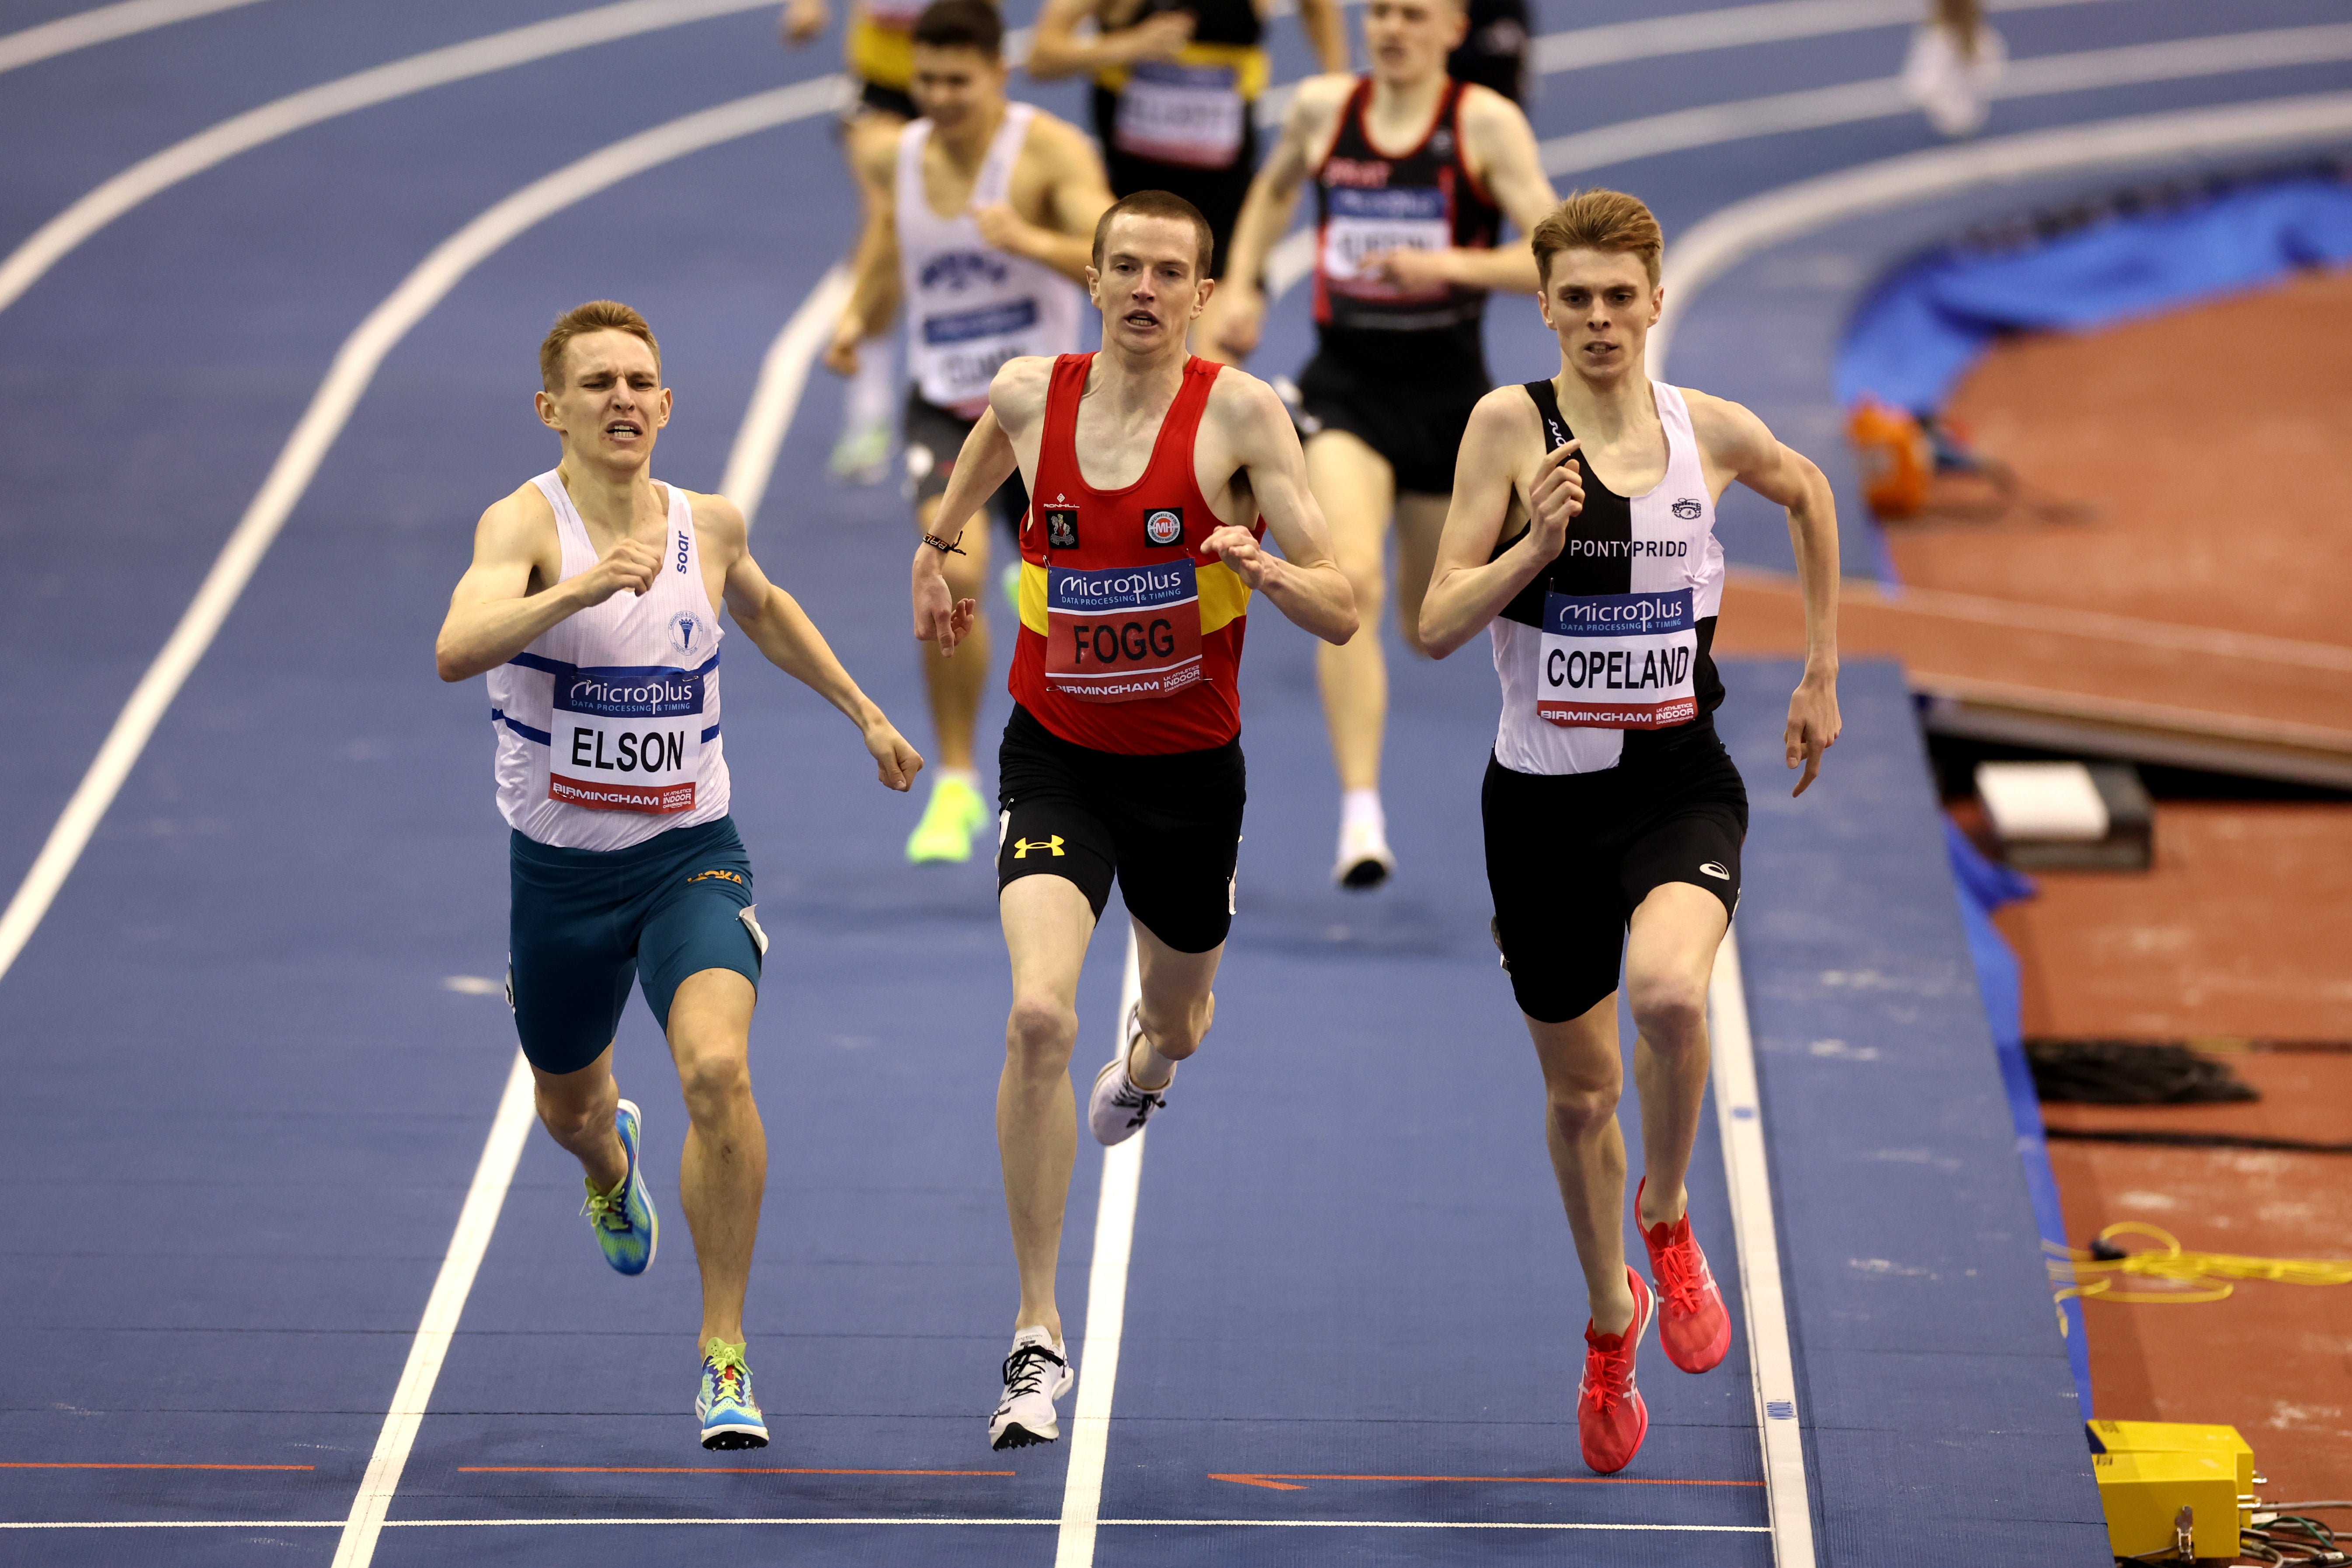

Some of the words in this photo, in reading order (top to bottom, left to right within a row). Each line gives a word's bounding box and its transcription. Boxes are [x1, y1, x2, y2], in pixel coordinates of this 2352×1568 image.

[1156, 522, 1173, 533] MH
[677, 530, 688, 574] soar
[1571, 540, 1687, 557] PONTYPRIDD
[1062, 596, 1079, 605] DATA
[1080, 595, 1135, 605] PROCESSING
[1149, 588, 1181, 600] TIMING
[1587, 622, 1641, 631] PROCESSING
[1655, 619, 1681, 628] TIMING
[1074, 619, 1174, 664] FOGG
[1172, 665, 1199, 678] ATHLETICS
[1547, 646, 1689, 689] COPELAND
[1164, 669, 1200, 688] INDOOR
[572, 700, 594, 709] DATA
[664, 702, 690, 711] TIMING
[1663, 702, 1693, 712] ATHLETICS
[1541, 710, 1652, 722] BIRMINGHAM
[1656, 708, 1694, 720] INDOOR
[572, 727, 684, 772] ELSON
[553, 782, 659, 806] BIRMINGHAM
[663, 793, 691, 804] INDOOR
